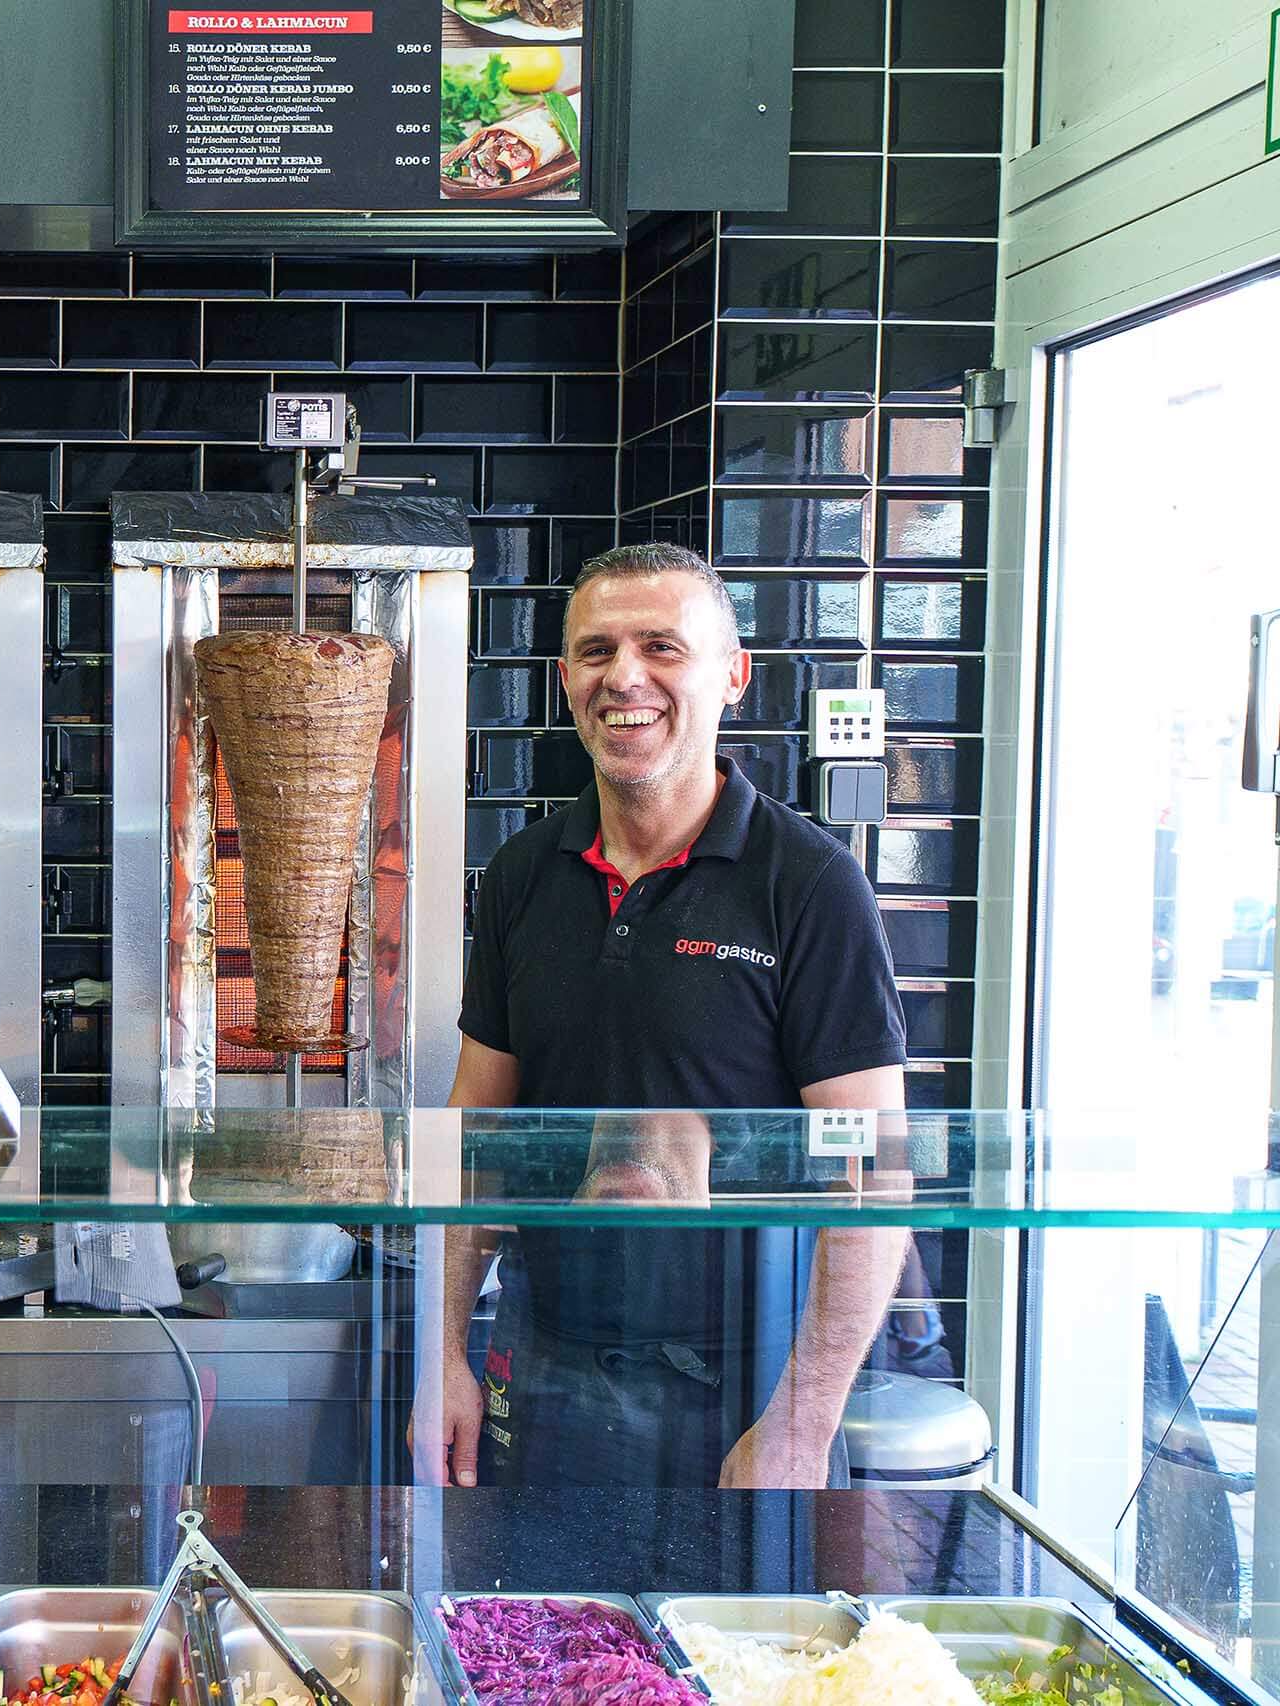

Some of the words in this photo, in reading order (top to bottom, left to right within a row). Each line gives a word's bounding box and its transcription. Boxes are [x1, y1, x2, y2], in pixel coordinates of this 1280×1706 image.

[187, 16, 238, 29] ROLLO
[240, 17, 254, 29] &
[256, 17, 348, 29] LAHMACUN
[187, 44, 225, 53] ROLLO
[227, 42, 268, 53] DÖNER
[270, 44, 312, 53] KEBAB
[397, 44, 421, 54] 9,50
[423, 44, 432, 53] €
[186, 84, 225, 94] ROLLO
[226, 83, 268, 94] DÖNER
[270, 85, 311, 94] KEBAB
[312, 85, 354, 94] JUMBO
[392, 84, 421, 94] 10,50
[423, 85, 431, 93] €
[168, 125, 180, 134] 17.
[186, 125, 254, 134] LAHMACUN
[256, 125, 290, 134] OHNE
[292, 125, 333, 134] KEBAB
[396, 124, 420, 134] 6,50
[422, 125, 431, 133] €
[186, 136, 201, 144] mit
[240, 136, 262, 144] Salat
[263, 136, 280, 144] und
[209, 146, 234, 154] Sauce
[236, 146, 256, 154] nach
[258, 146, 281, 154] Wahl
[186, 157, 254, 166] LAHMACUN
[256, 157, 280, 166] MIT
[282, 157, 322, 165] KEBAB
[396, 157, 420, 166] 8,00
[422, 157, 431, 165] €
[186, 176, 206, 184] Salat
[208, 176, 222, 184] und
[675, 939, 776, 968] ggmgastro
